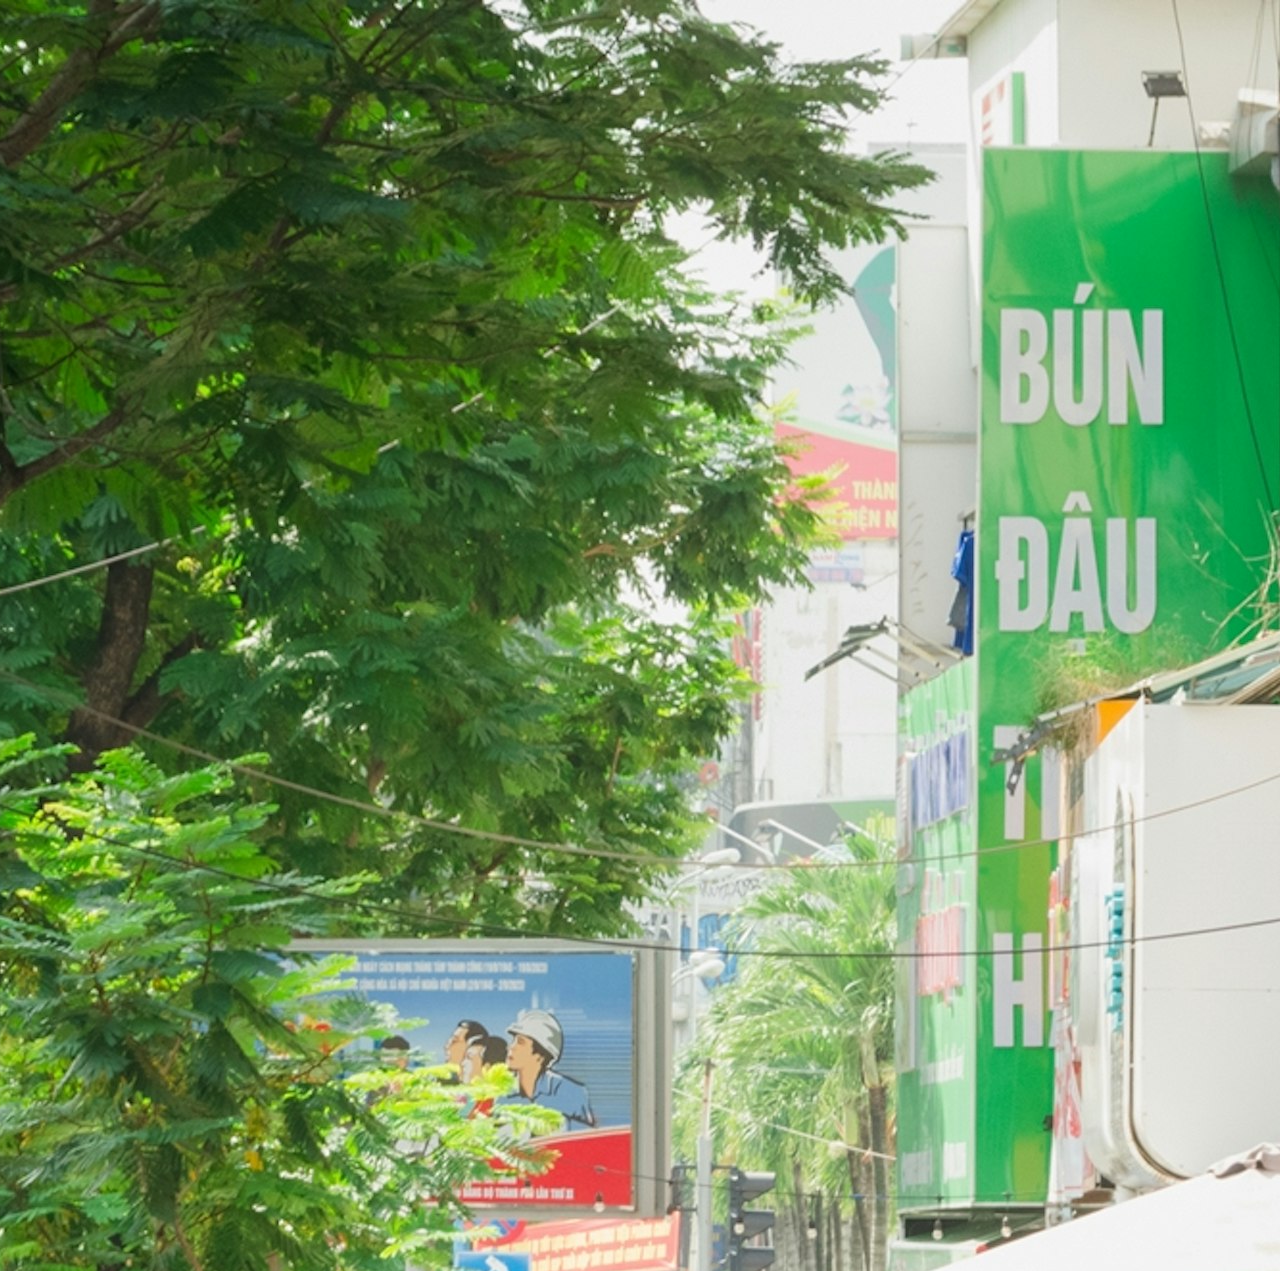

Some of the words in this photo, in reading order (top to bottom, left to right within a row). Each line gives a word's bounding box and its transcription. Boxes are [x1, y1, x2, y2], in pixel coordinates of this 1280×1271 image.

[999, 282, 1164, 426] BÚN
[852, 477, 897, 501] THÀN
[994, 491, 1157, 657] ĐẬU
